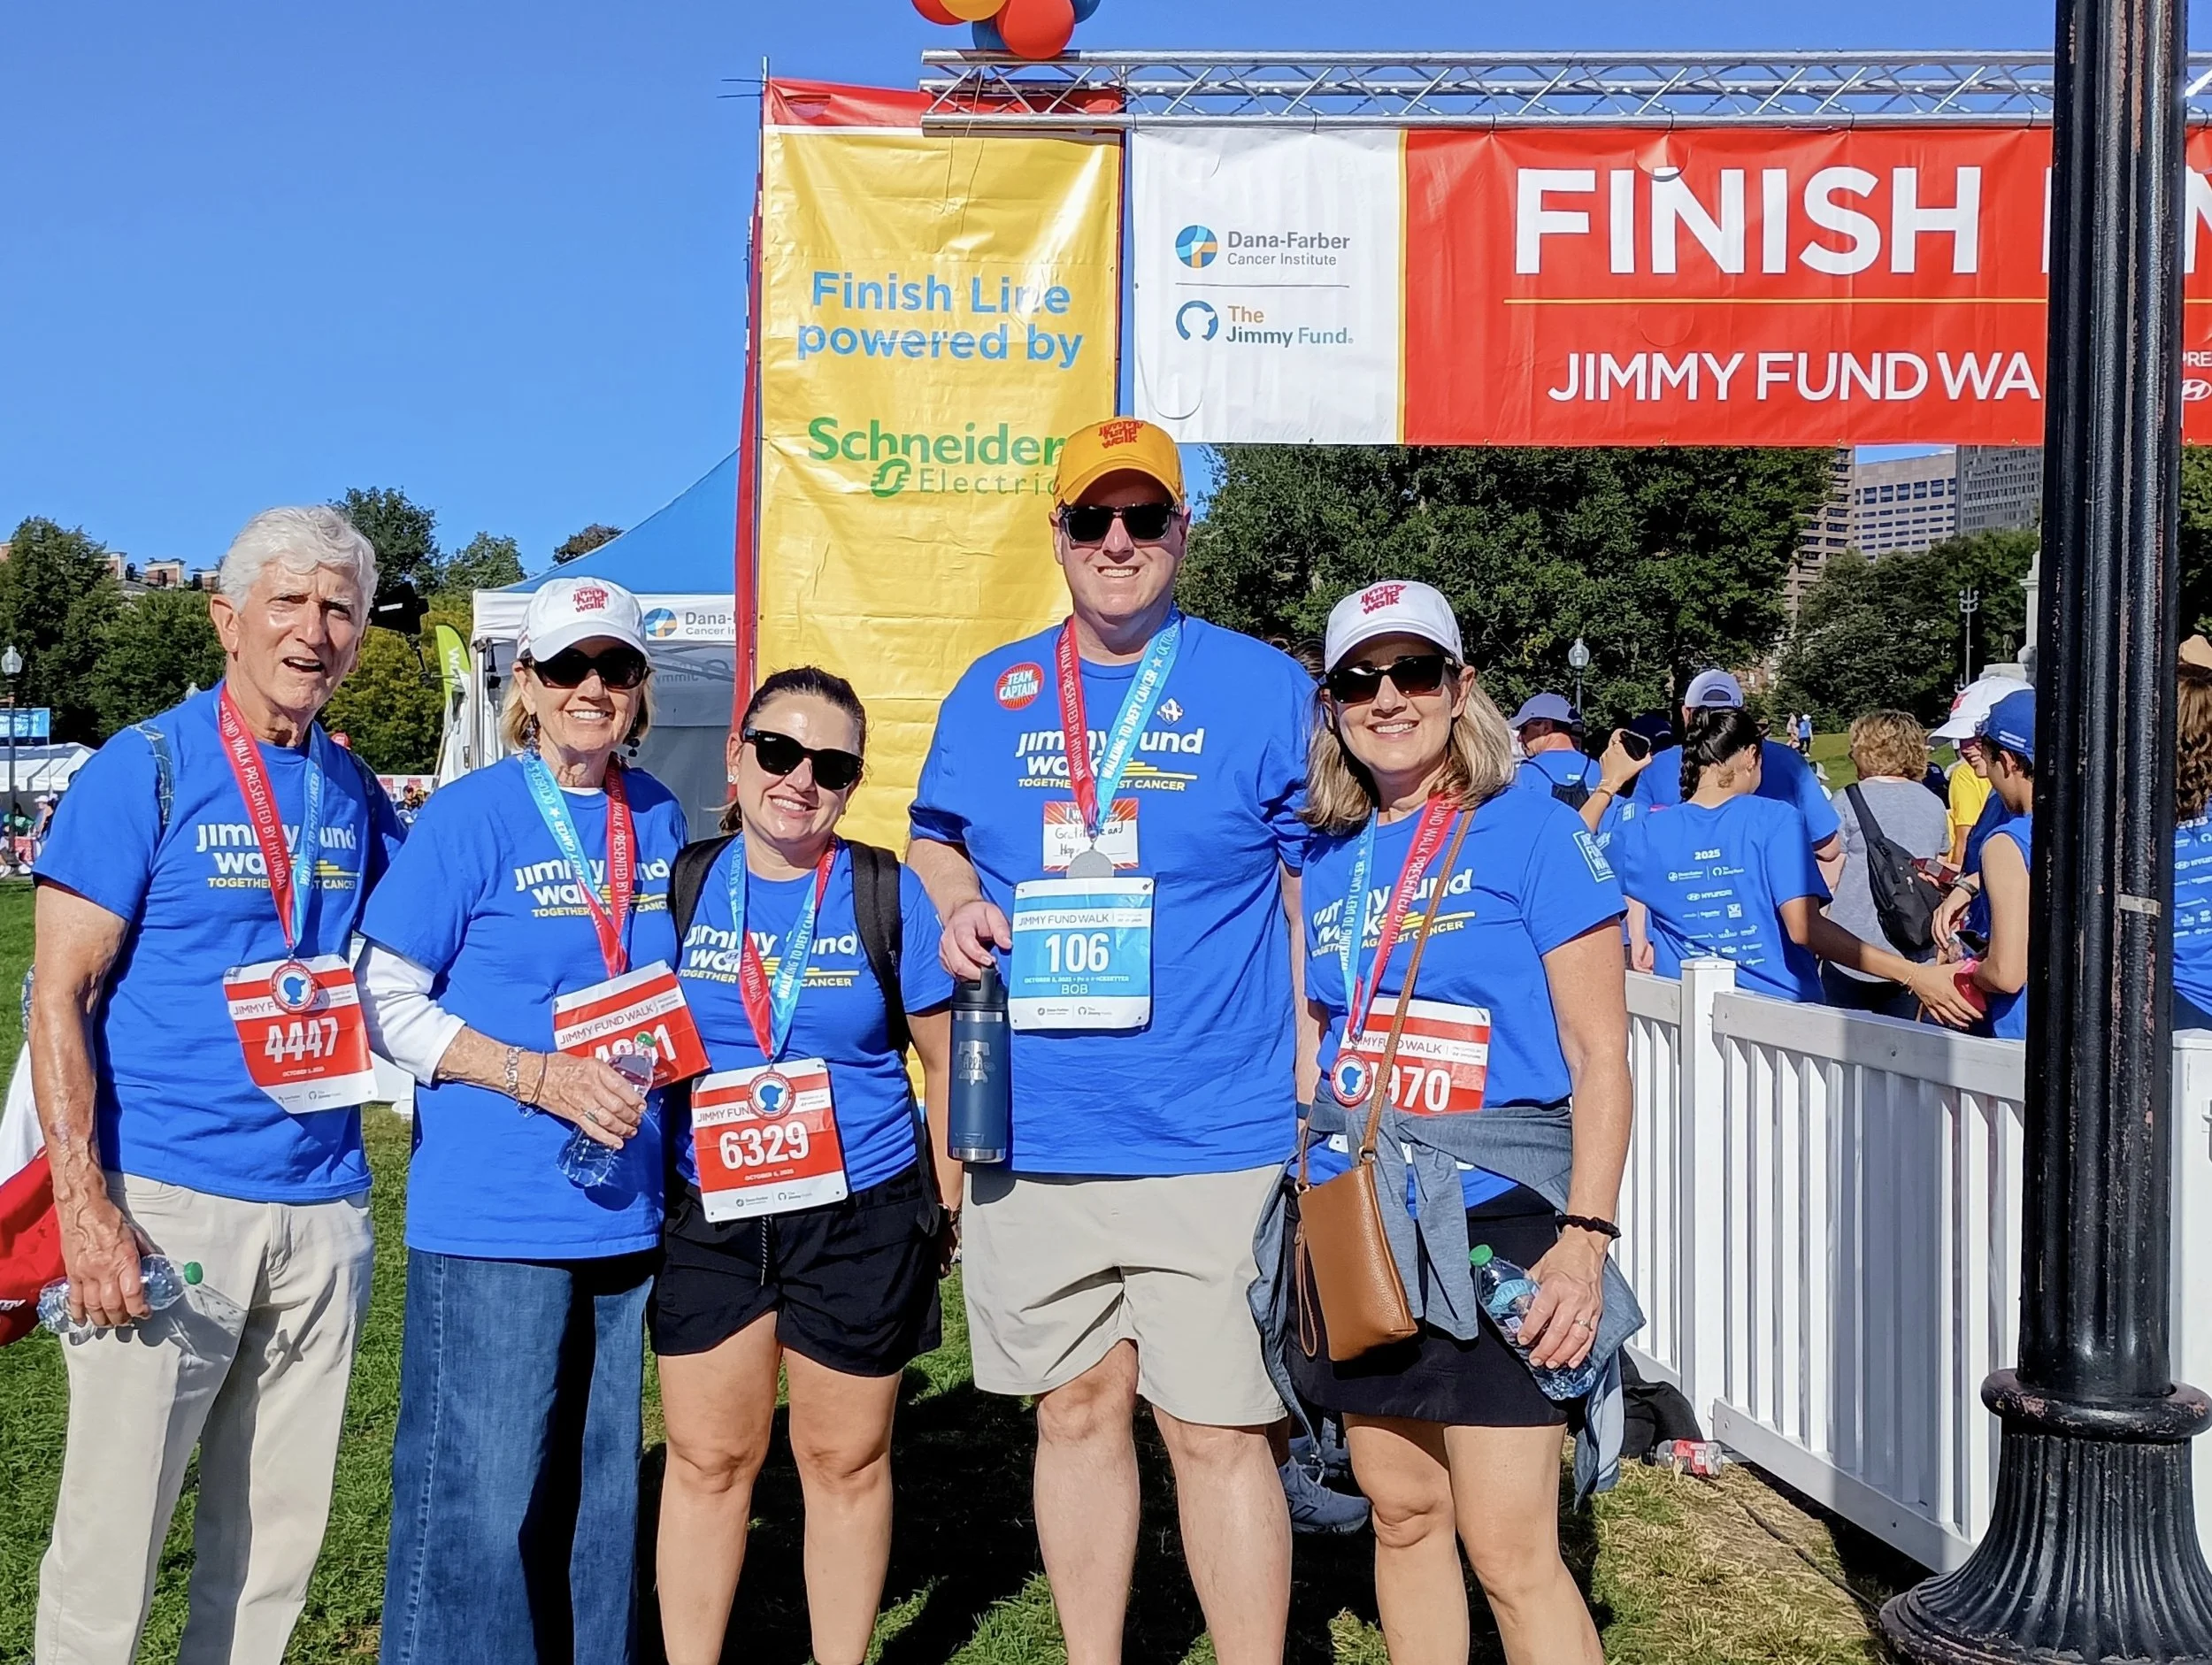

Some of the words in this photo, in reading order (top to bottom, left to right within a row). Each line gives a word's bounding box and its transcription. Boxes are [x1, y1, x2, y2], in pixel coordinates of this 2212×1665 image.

[1516, 165, 1981, 275] FINISH
[1227, 231, 1350, 250] Dana-Farber
[1227, 252, 1275, 265] Cancer
[1279, 251, 1337, 266] Institute
[812, 271, 950, 312] Finish
[1227, 306, 1264, 324] The
[1225, 325, 1292, 348] Jimmy
[1298, 327, 1348, 344] Fund
[797, 324, 1007, 362] powered
[1027, 324, 1083, 370] by
[1548, 352, 1746, 402] JIMMY
[1757, 352, 1928, 401] FUND
[1938, 351, 2041, 400] WA
[808, 418, 1065, 466] Schneider
[685, 612, 736, 625] Dana-
[1060, 643, 1072, 672] WALK
[1008, 669, 1033, 685] TEAM
[1134, 669, 1159, 703] CANCER
[999, 681, 1039, 701] CAPTAIN
[1063, 671, 1079, 725] PRESENTED
[1125, 701, 1144, 726] DEFY
[1069, 723, 1080, 737] BY
[1118, 722, 1134, 739] TO
[232, 736, 254, 767] WALK
[1140, 728, 1206, 755] und
[1071, 736, 1087, 782] HYUNDAI
[1101, 735, 1129, 779] WALKING
[1018, 779, 1072, 788] TOGETHE
[1134, 779, 1187, 791] CANCER
[242, 765, 273, 824] PRESENTED
[613, 802, 624, 827] WALK
[263, 825, 276, 840] BY
[1417, 827, 1440, 854] WALK
[613, 829, 628, 879] PRESENTED
[1694, 848, 1721, 860] 2025
[267, 841, 288, 889] HYUNDAI
[207, 878, 272, 889] TOGETHE
[616, 880, 629, 893] BY
[1018, 916, 1047, 926] JIMMY
[1048, 915, 1077, 925] FUND
[1079, 913, 1109, 924] WALK
[1341, 915, 1355, 928] TO
[1412, 920, 1464, 940] CNCER
[795, 931, 809, 951] DEFY
[790, 949, 803, 962] TO
[1045, 932, 1110, 973] 106
[680, 969, 737, 983] TOGETHER
[777, 961, 799, 1000] WALKING
[801, 978, 852, 987] CANCER
[1062, 984, 1088, 994] BOB
[234, 1001, 267, 1016] JIMMY
[560, 1026, 593, 1045] JIMMY
[595, 1015, 624, 1035] FUND
[624, 1004, 654, 1023] WALK
[265, 1017, 339, 1063] 4447
[1404, 1040, 1442, 1055] WALK
[697, 1109, 726, 1123] JIMMY
[727, 1107, 754, 1118] FUN
[719, 1121, 810, 1170] 6329
